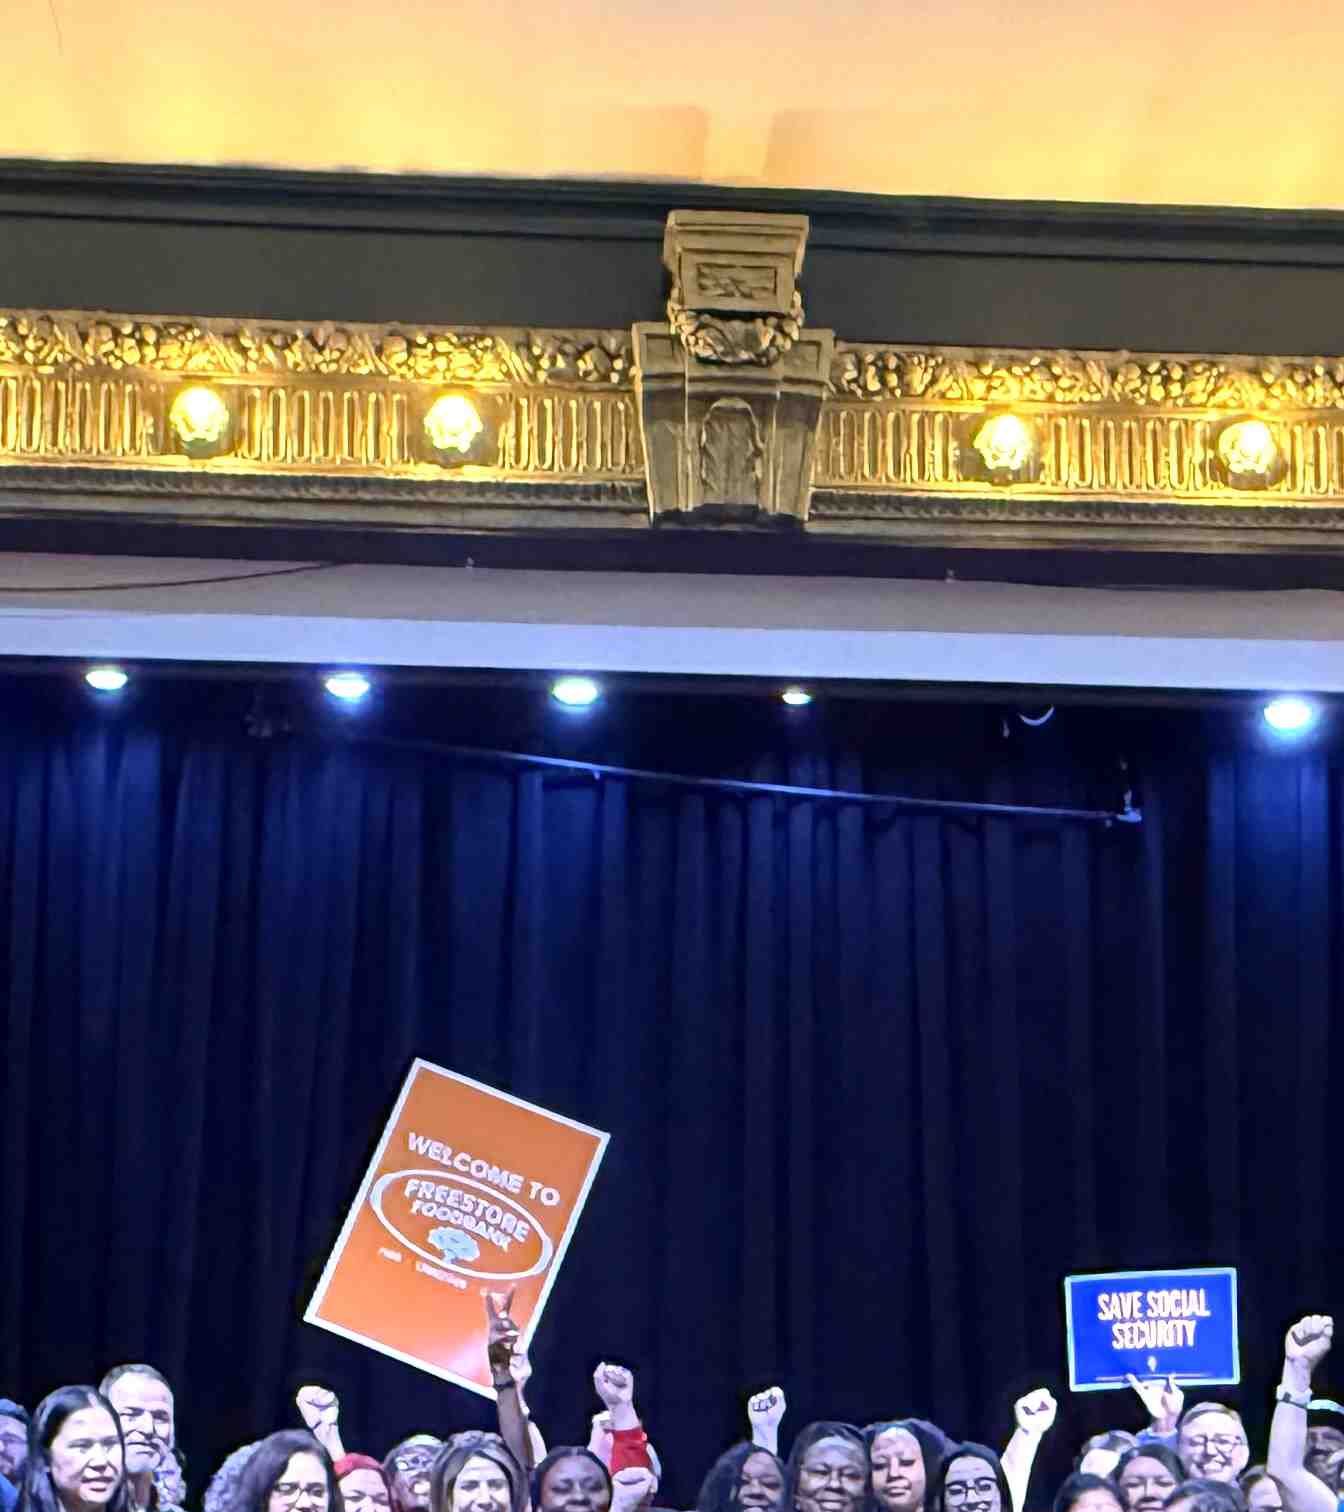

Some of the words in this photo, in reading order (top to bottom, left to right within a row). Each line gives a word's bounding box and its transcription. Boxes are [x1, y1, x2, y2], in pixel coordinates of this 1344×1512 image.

[408, 1132, 524, 1194] WELCOME
[530, 1180, 561, 1206] TO
[404, 1178, 531, 1242] FREESTORE
[411, 1199, 513, 1251] FOODBANK
[1097, 1291, 1144, 1321] SAVE
[1146, 1288, 1212, 1318] SOCIAL
[1112, 1319, 1197, 1350] SECURITY
